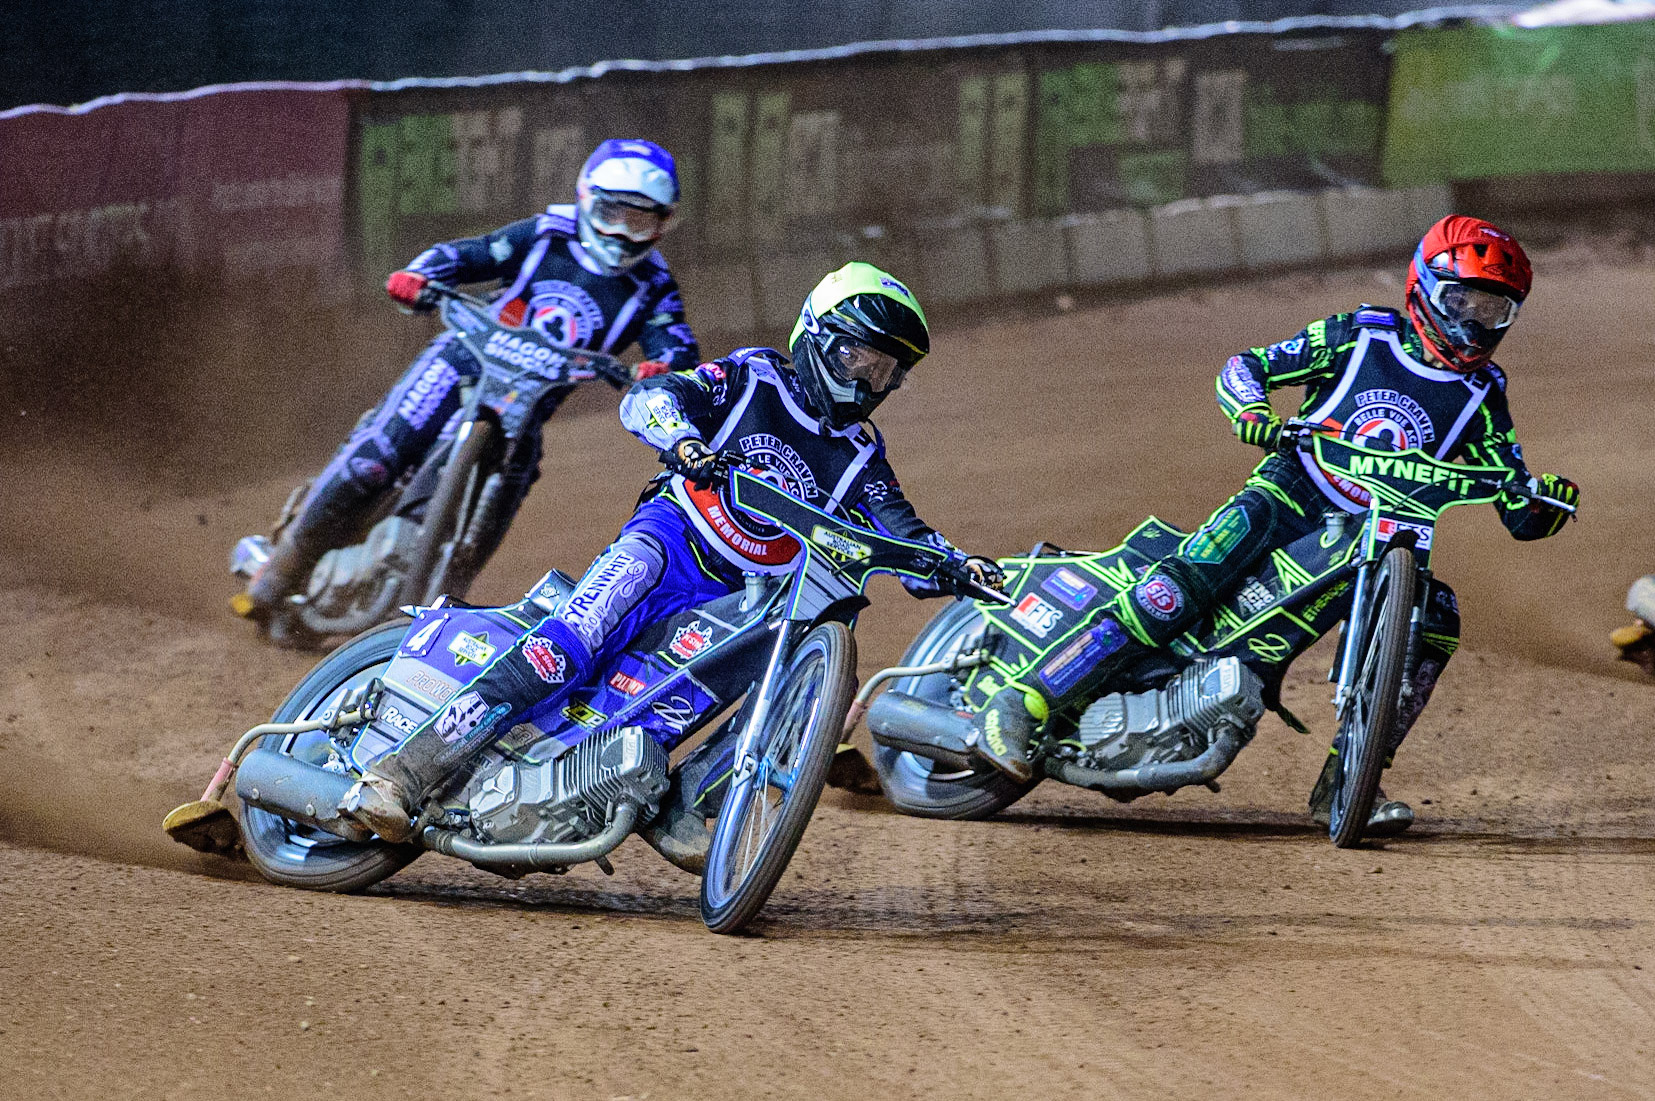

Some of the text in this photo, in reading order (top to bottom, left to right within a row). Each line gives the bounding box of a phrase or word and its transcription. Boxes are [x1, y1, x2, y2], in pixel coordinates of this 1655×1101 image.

[487, 331, 567, 368] HAGON
[399, 358, 449, 418] HAGON
[1354, 409, 1417, 448] BELLE VUE ACE
[1355, 389, 1435, 443] PETER CRAVEN
[739, 433, 819, 498] PETER CRAVEN
[1350, 455, 1475, 495] MYNEFIT
[707, 505, 767, 556] MEMORIAL
[824, 531, 861, 550] AUSTRALIAN
[826, 541, 854, 556] SERVICES
[565, 554, 631, 620] YRENWHIT
[1147, 585, 1172, 606] STS
[1027, 602, 1060, 629] FTS
[409, 618, 443, 651] 4
[407, 670, 456, 702] PROWO
[381, 706, 418, 734] RACE
